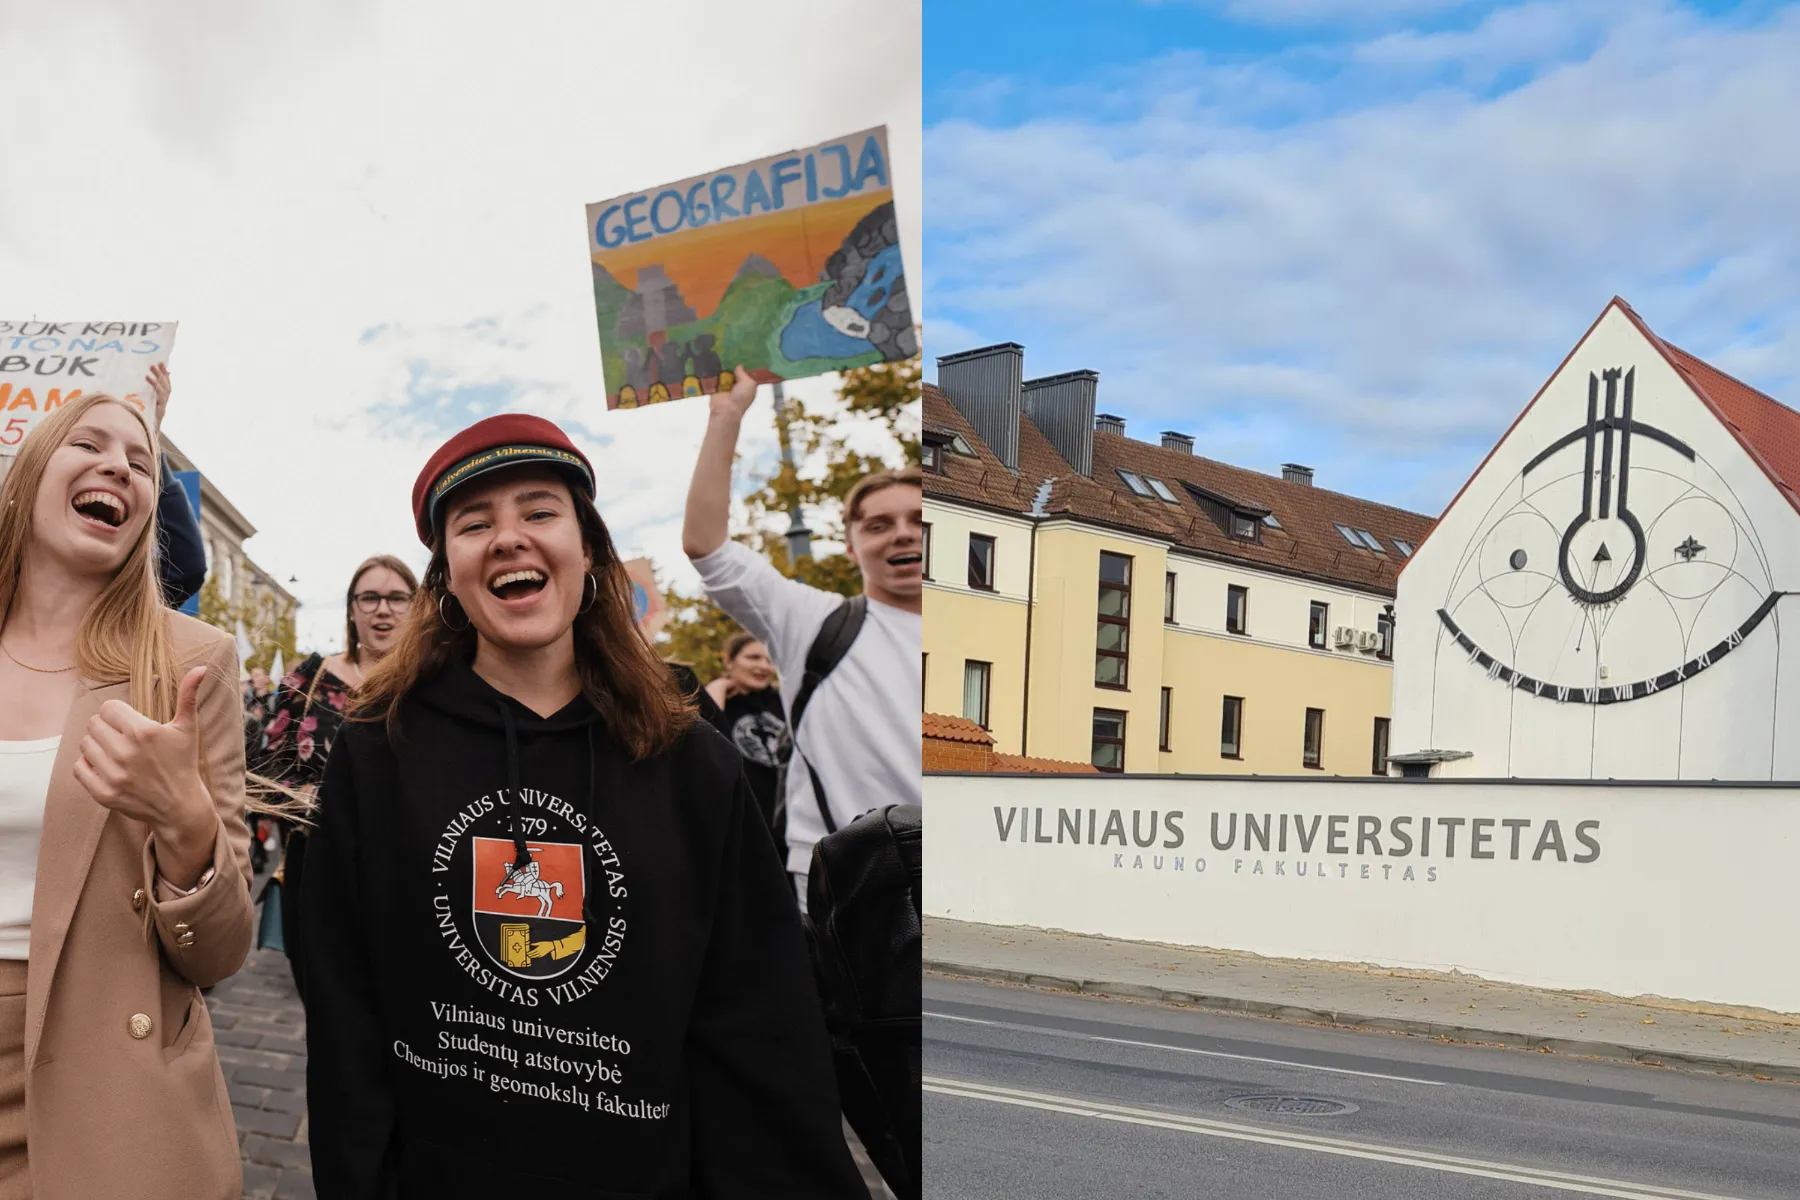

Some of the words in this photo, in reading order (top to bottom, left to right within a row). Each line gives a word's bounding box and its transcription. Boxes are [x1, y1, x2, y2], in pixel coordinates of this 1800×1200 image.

[596, 135, 889, 249] GEOGRAFIJA
[0, 336, 161, 355] TONAS
[81, 321, 162, 337] KAIP
[495, 447, 553, 458] Vilnensis
[1557, 685, 1570, 702] VI
[1582, 686, 1600, 703] VII
[1613, 684, 1633, 701] VIII
[1645, 676, 1660, 695] IX
[1674, 664, 1687, 682] X
[1696, 652, 1712, 671] XI
[1725, 629, 1745, 651] XII
[432, 795, 495, 874] VILNIAUS
[993, 806, 1185, 849] VILNIAUS
[1210, 811, 1601, 864] UNIVERSITETAS
[1113, 853, 1207, 873] KAUNO
[1233, 858, 1438, 883] FAKULTETAS
[433, 894, 540, 1007] UNIVERSITAS
[545, 916, 628, 1006] VILNENSIS
[429, 1000, 506, 1031] Vilniaus
[511, 1017, 632, 1055] universiteto
[393, 1039, 468, 1080] Chemijos
[473, 1061, 486, 1082] ir
[489, 1073, 590, 1112] geomokslų
[595, 1090, 671, 1120] fakultet
[438, 1030, 520, 1069] Studentų
[525, 1051, 623, 1084] atstovybė
